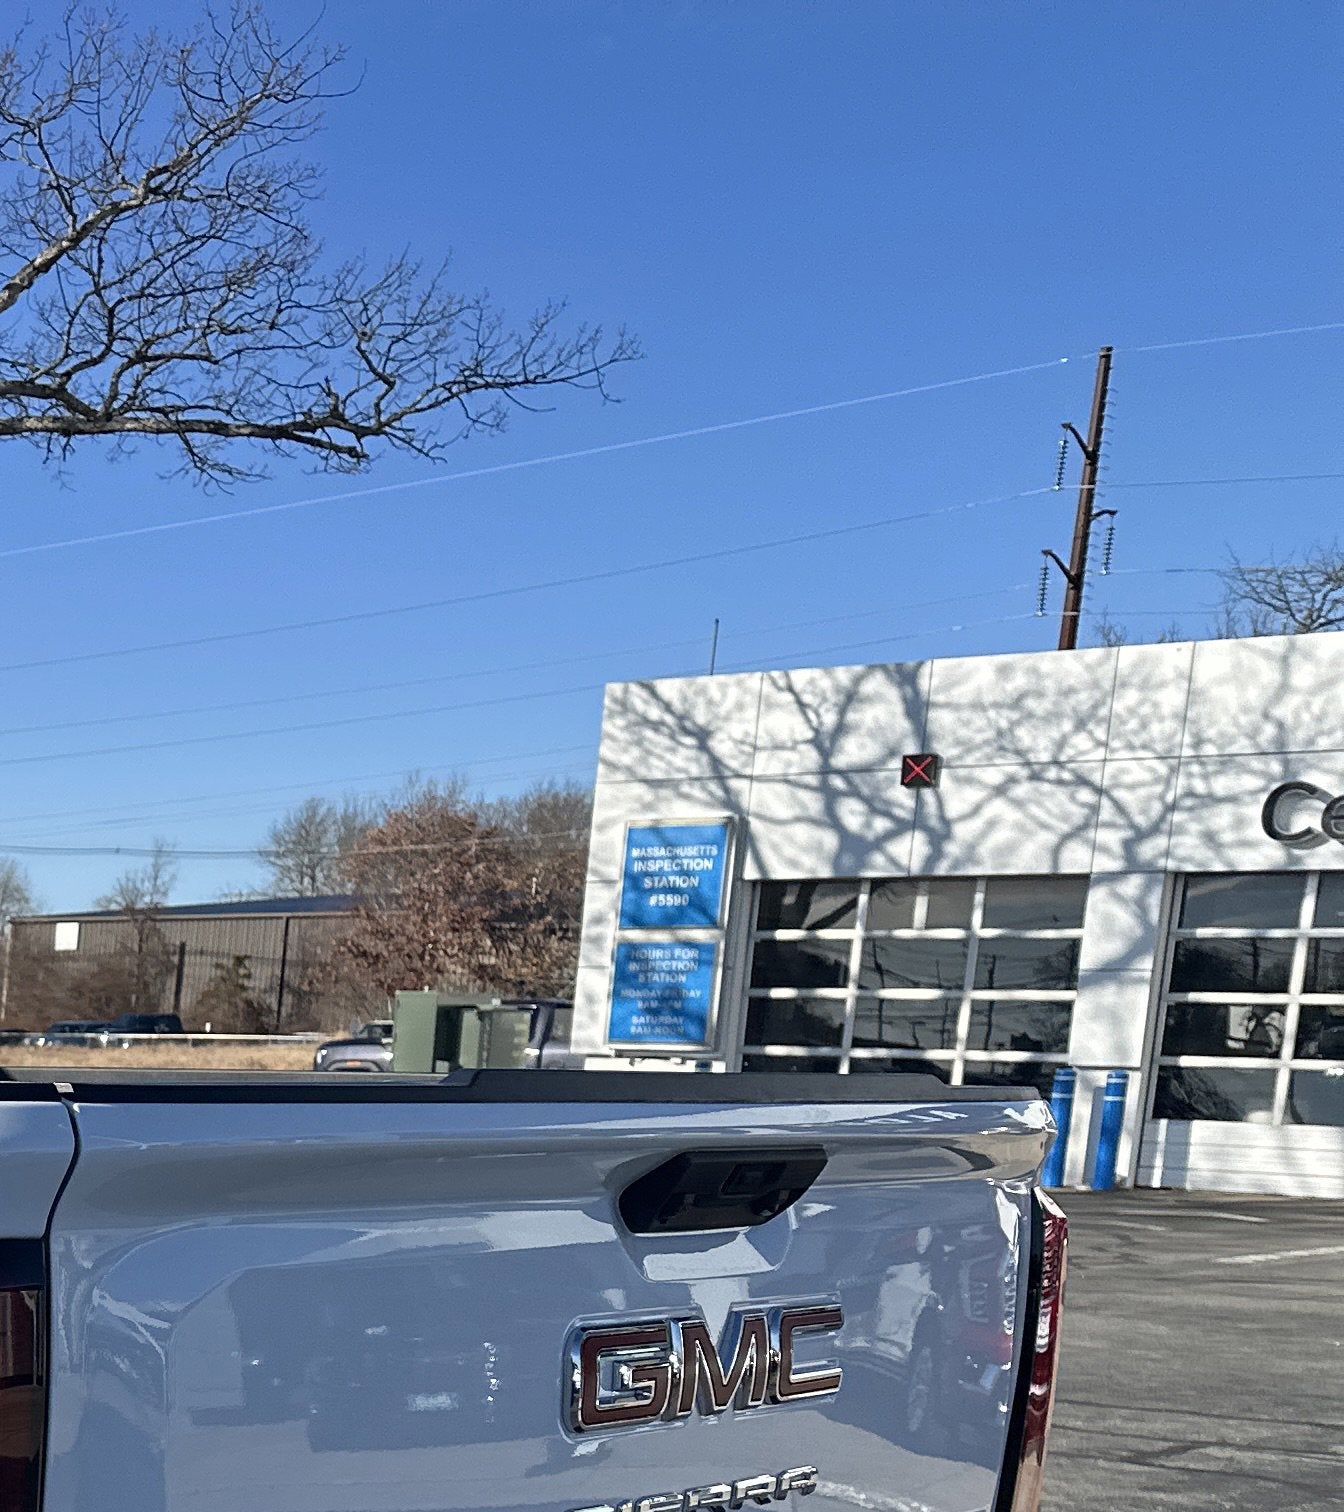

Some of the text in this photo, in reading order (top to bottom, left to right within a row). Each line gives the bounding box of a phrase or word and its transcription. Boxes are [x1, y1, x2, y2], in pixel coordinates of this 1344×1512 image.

[632, 844, 718, 857] MASSACHUSETTS
[633, 858, 713, 872] INSPECTION
[643, 876, 699, 889] STATION
[631, 948, 699, 960] HOURS FOR
[628, 960, 698, 971] INSPECTION
[639, 972, 687, 983] STATION
[561, 1299, 845, 1440] GMC
